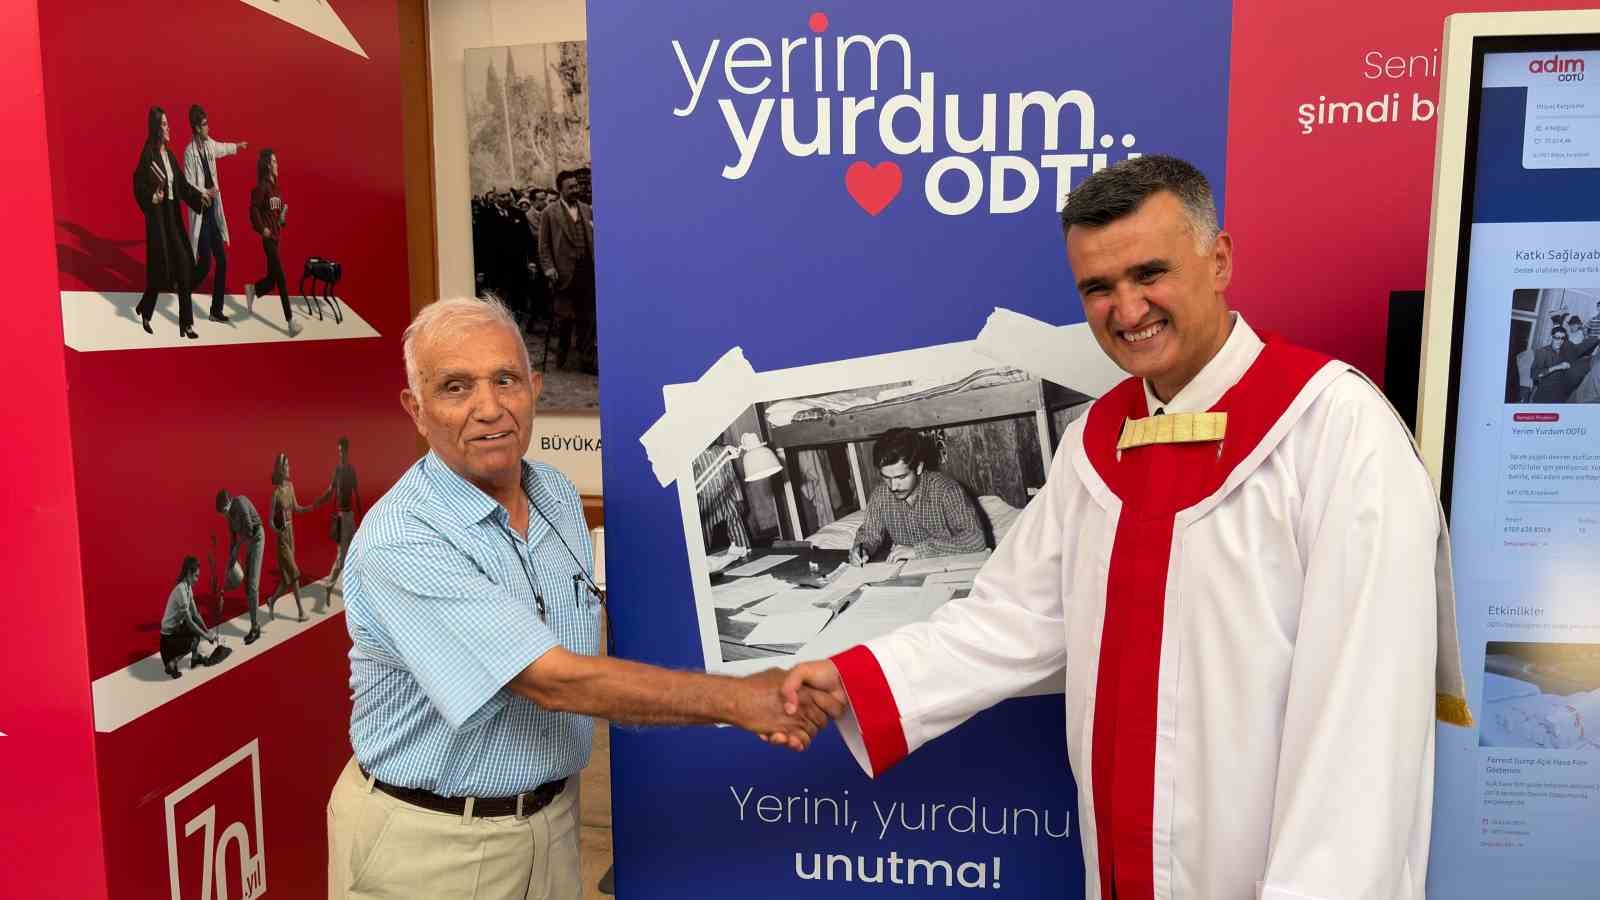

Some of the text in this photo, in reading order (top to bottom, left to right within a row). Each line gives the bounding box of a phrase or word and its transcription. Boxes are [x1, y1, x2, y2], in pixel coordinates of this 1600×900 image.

[671, 12, 912, 117] yerim
[1364, 48, 1438, 79] Seni
[1529, 55, 1584, 73] adım
[1558, 72, 1584, 82] ODTÜ
[717, 72, 1095, 180] yurdum
[1298, 93, 1440, 135] şimdi b
[1515, 248, 1545, 261] Katkı
[1487, 606, 1545, 617] Etkinlikler
[729, 785, 1071, 839] Yerini, yurdunu
[795, 850, 1001, 890] unutma!
